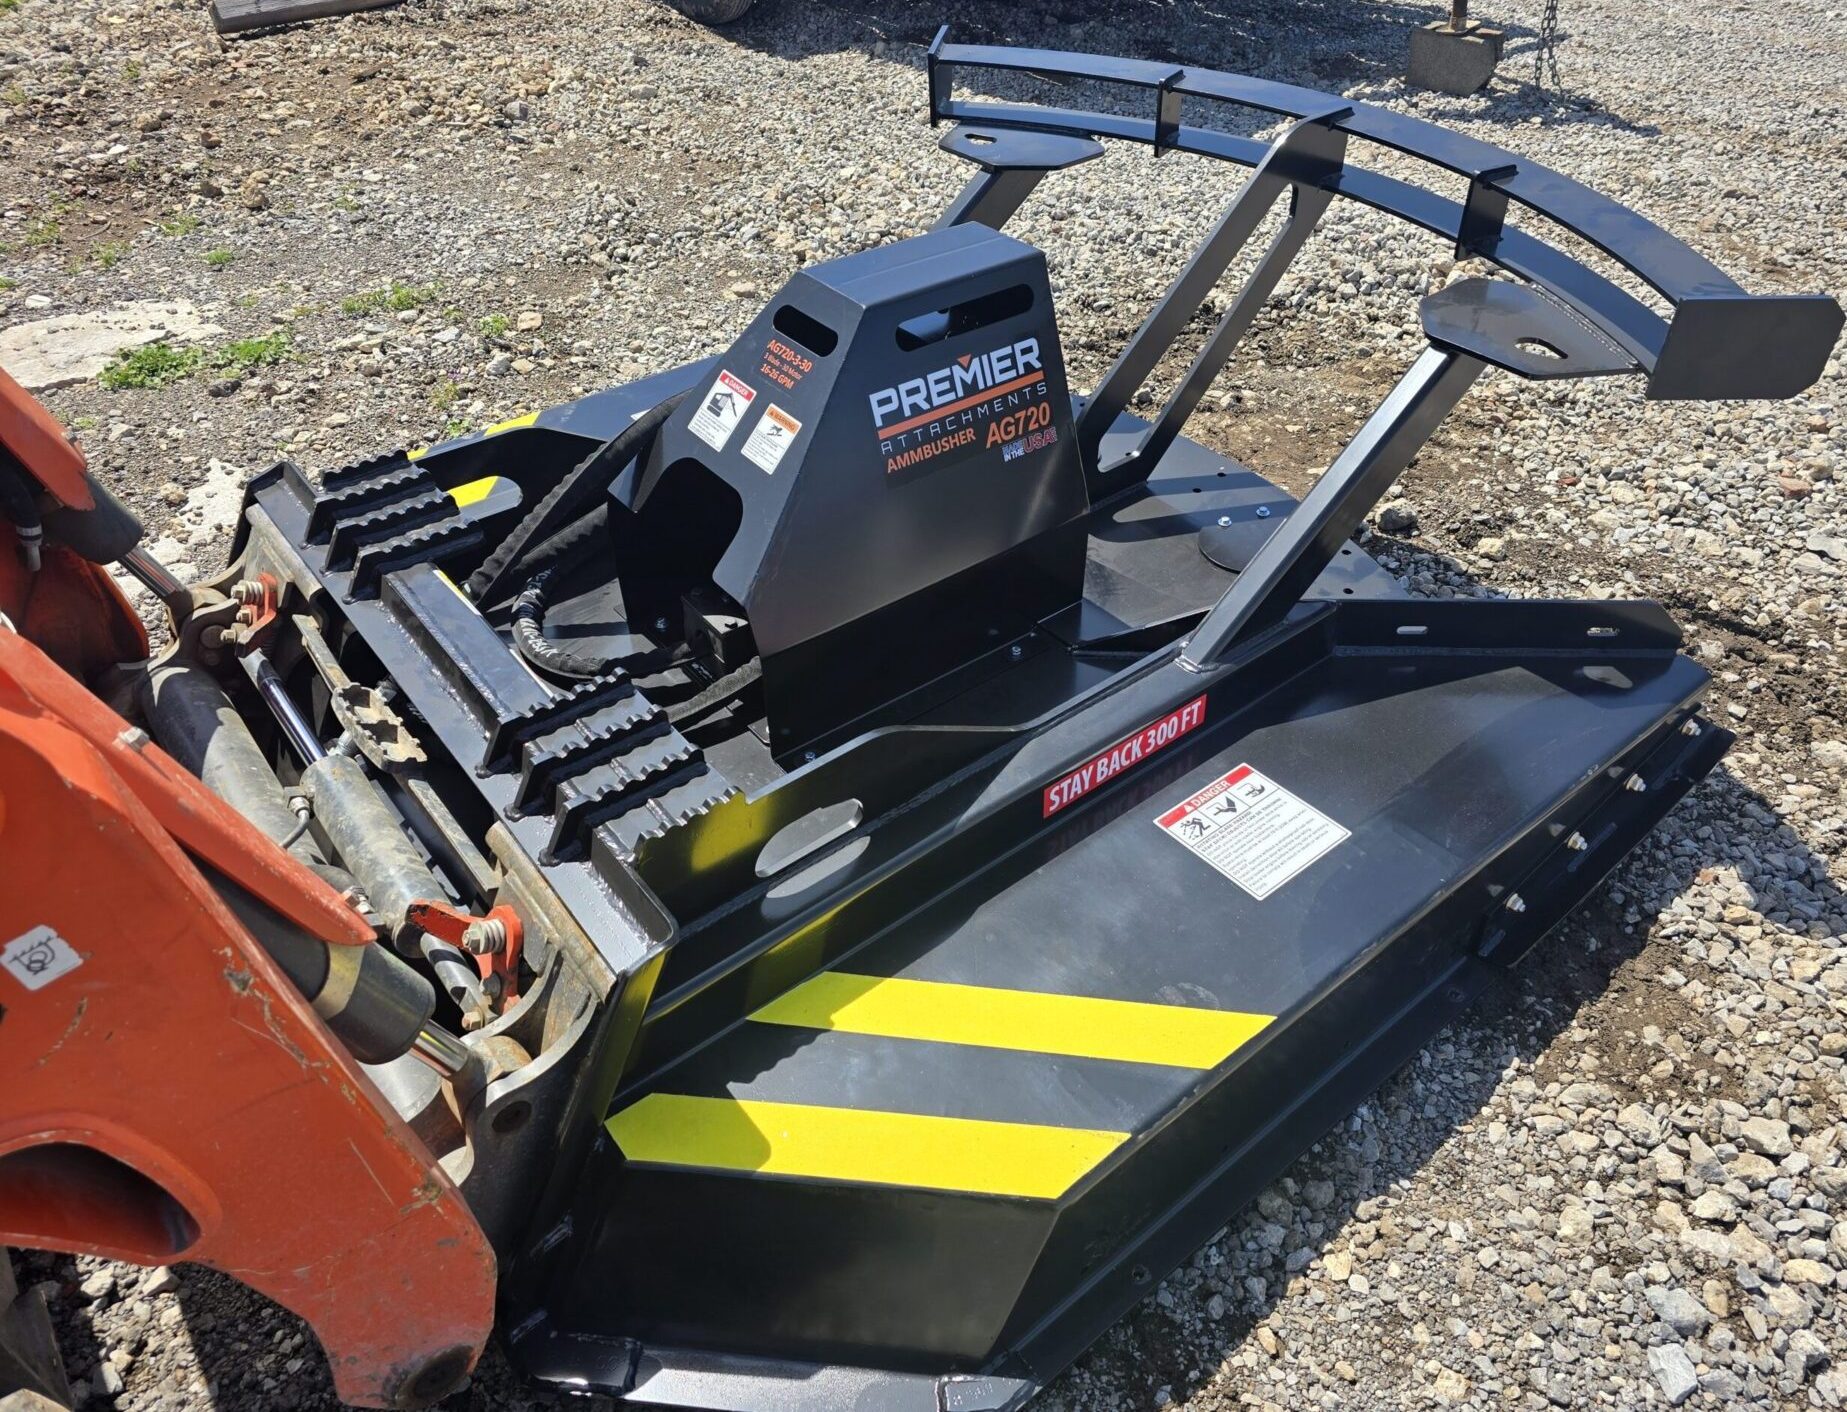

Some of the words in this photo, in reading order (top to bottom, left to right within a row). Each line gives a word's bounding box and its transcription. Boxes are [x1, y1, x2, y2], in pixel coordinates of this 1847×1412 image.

[767, 339, 813, 373] AG720-3-30
[777, 374, 795, 390] GPM
[869, 337, 1042, 427] PREMIER
[880, 382, 1047, 455] ATTACHMENTS
[985, 402, 1050, 449] AG720
[887, 427, 976, 474] AMMBUSHER
[1049, 766, 1095, 812] STAY
[1096, 738, 1143, 783] BACK
[1145, 715, 1179, 753] 300
[1180, 700, 1203, 732] FT
[1190, 780, 1231, 807] DANGER
